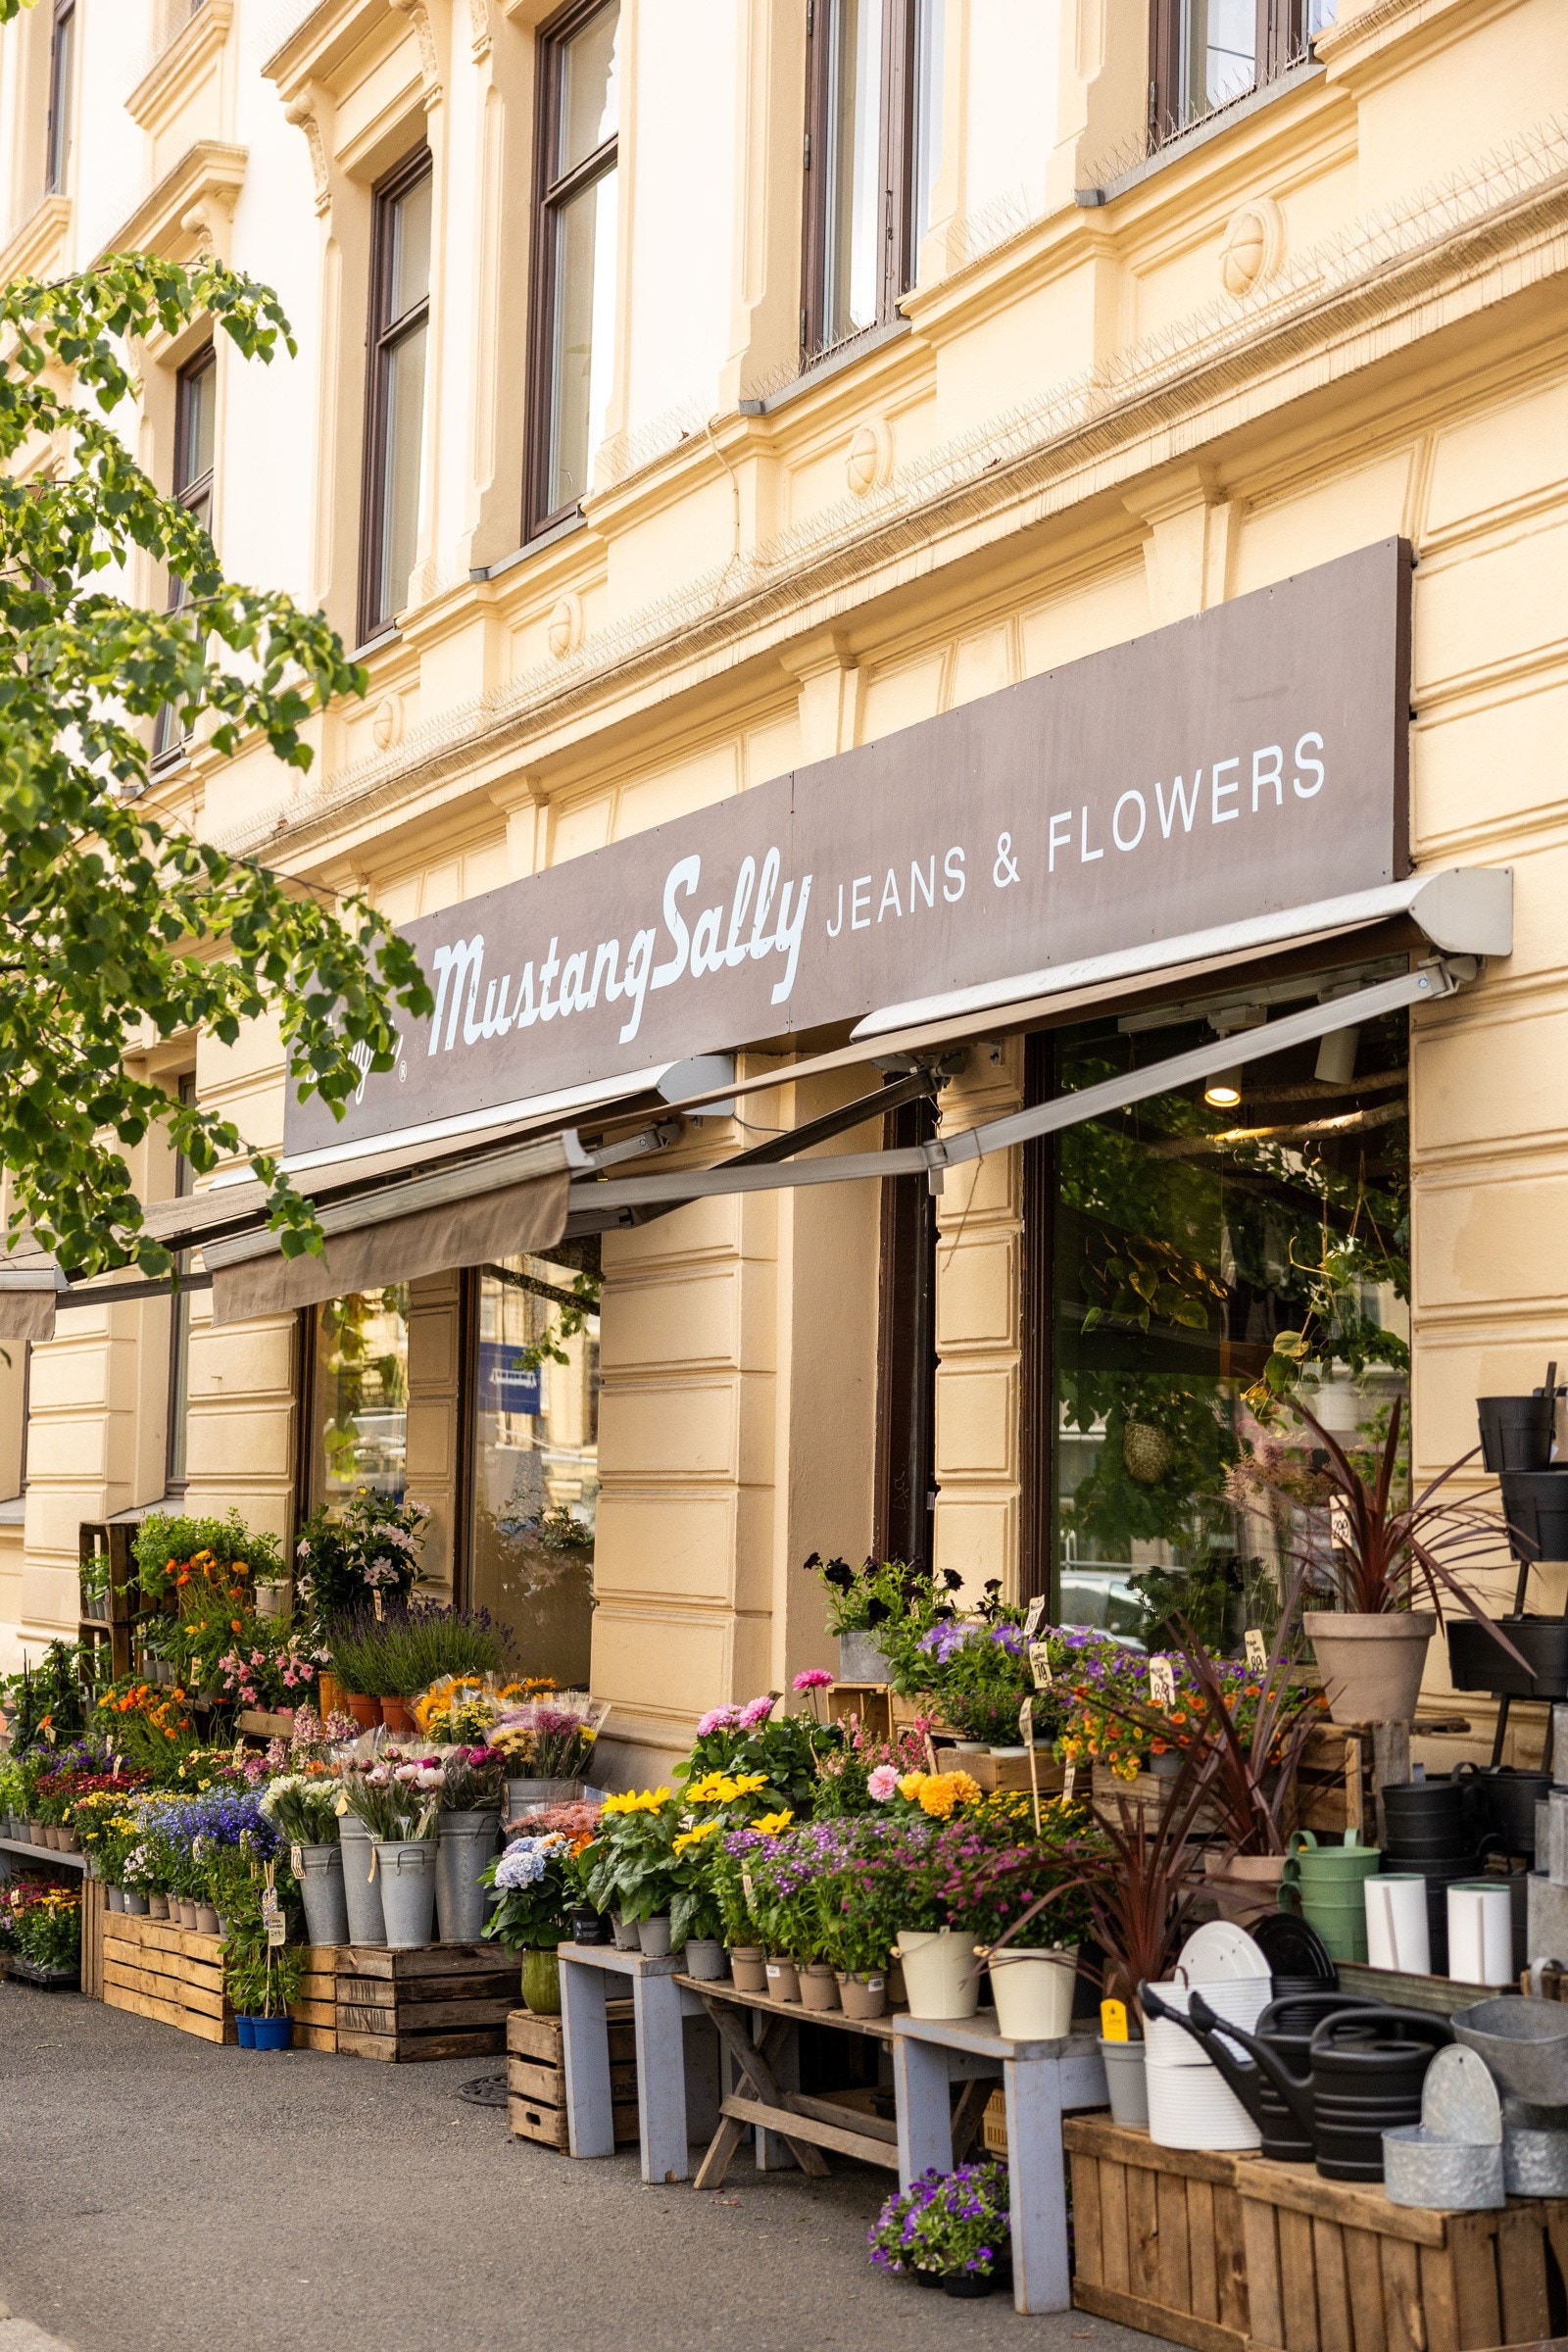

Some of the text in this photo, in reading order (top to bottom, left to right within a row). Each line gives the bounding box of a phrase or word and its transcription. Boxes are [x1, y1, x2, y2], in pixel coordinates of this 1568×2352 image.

[826, 846, 966, 938] JEANS
[992, 831, 1020, 888] &
[1048, 730, 1326, 873] FLOWERS
